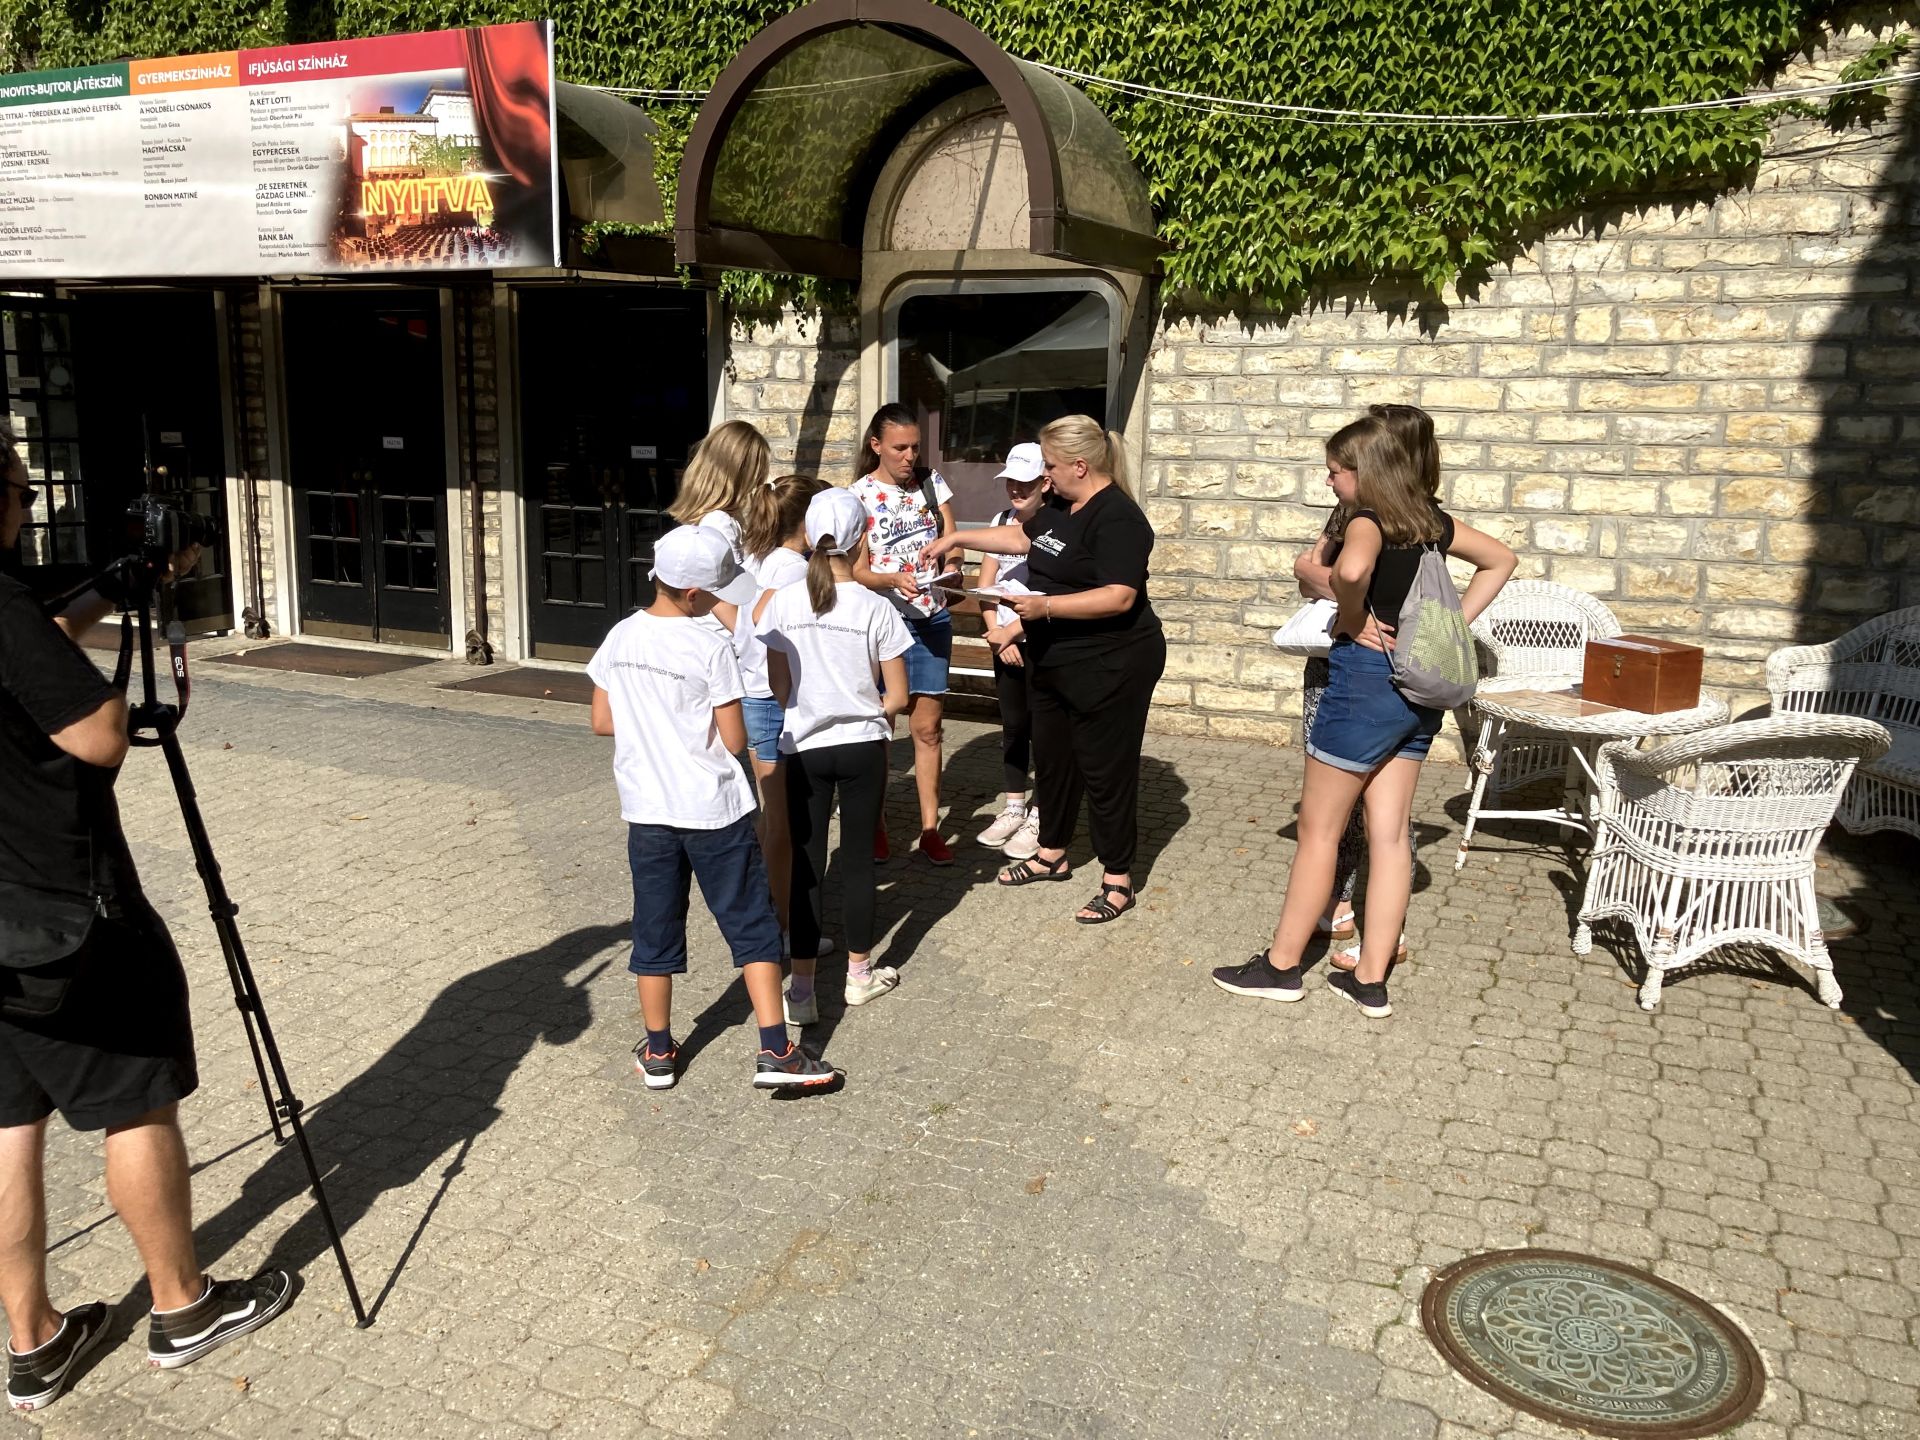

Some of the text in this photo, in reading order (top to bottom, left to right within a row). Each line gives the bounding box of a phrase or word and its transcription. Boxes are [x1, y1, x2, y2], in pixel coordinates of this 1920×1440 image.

[138, 64, 232, 85] GYERMEKSZÍNHÁZ
[248, 53, 348, 77] IFJÚSÁGI SZÍNHÁZ
[73, 73, 122, 93] JÁTÉKSZÍN
[270, 96, 292, 105] LOTTI
[252, 147, 300, 157] EGYPERCESEK
[144, 193, 173, 201] BONBON
[256, 191, 284, 200] GAZDAG
[362, 175, 494, 217] NYITVA
[174, 656, 185, 678] EOS
